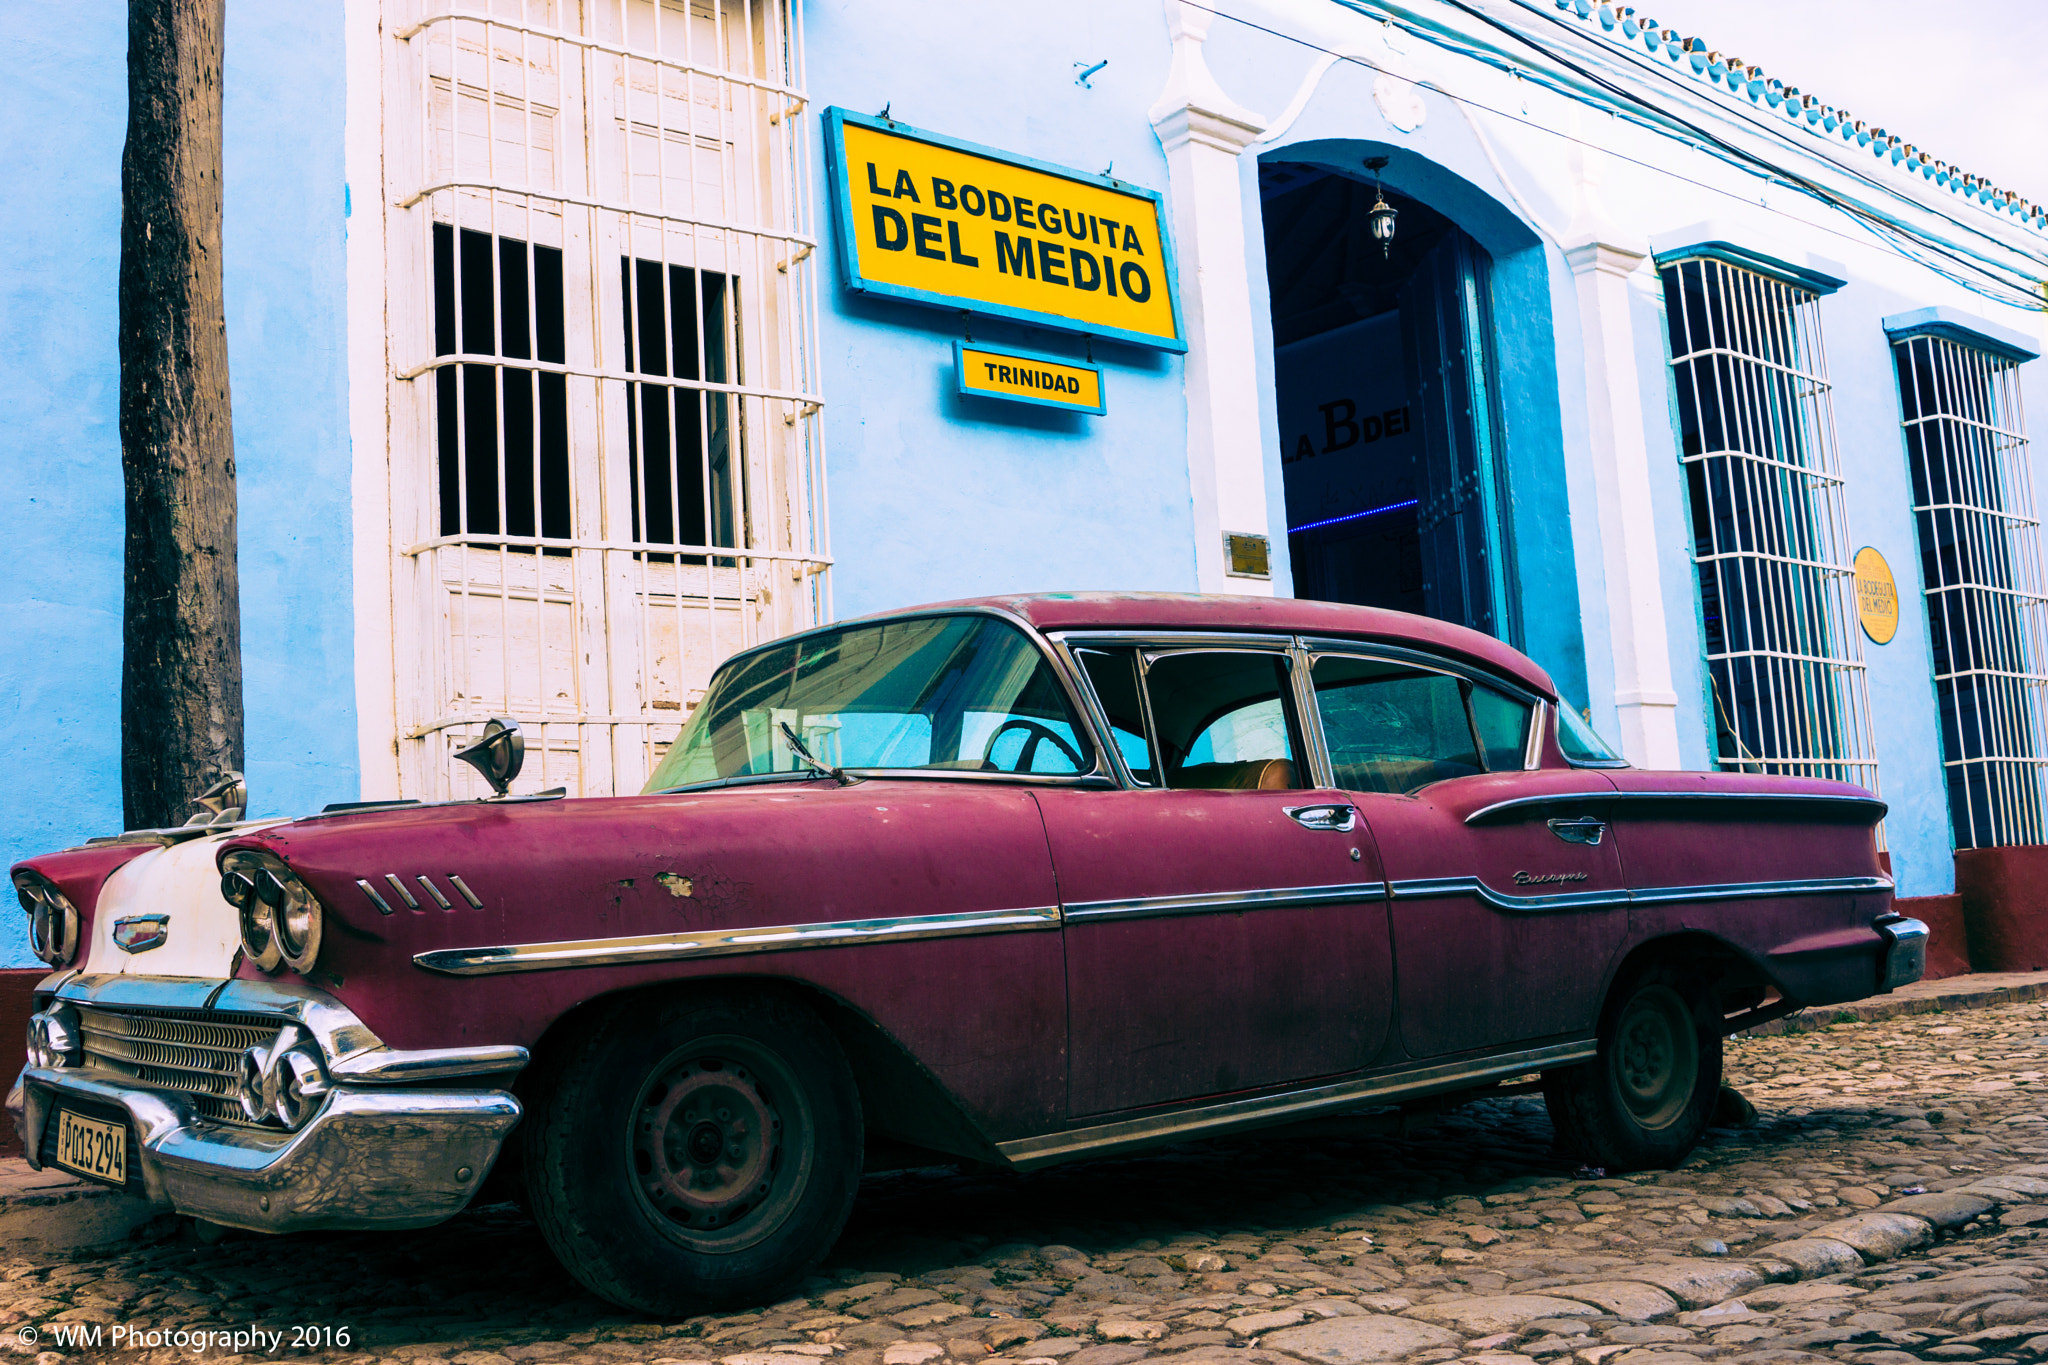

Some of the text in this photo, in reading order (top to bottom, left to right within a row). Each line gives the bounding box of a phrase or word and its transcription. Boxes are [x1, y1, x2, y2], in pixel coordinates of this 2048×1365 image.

[866, 162, 1145, 256] LA BODEGUITA
[871, 204, 1151, 303] DEL MEDIO
[984, 363, 1080, 394] TRINIDAD
[1863, 579, 1893, 597] BODEGUITA
[1861, 597, 1892, 615] DEL MEDIO
